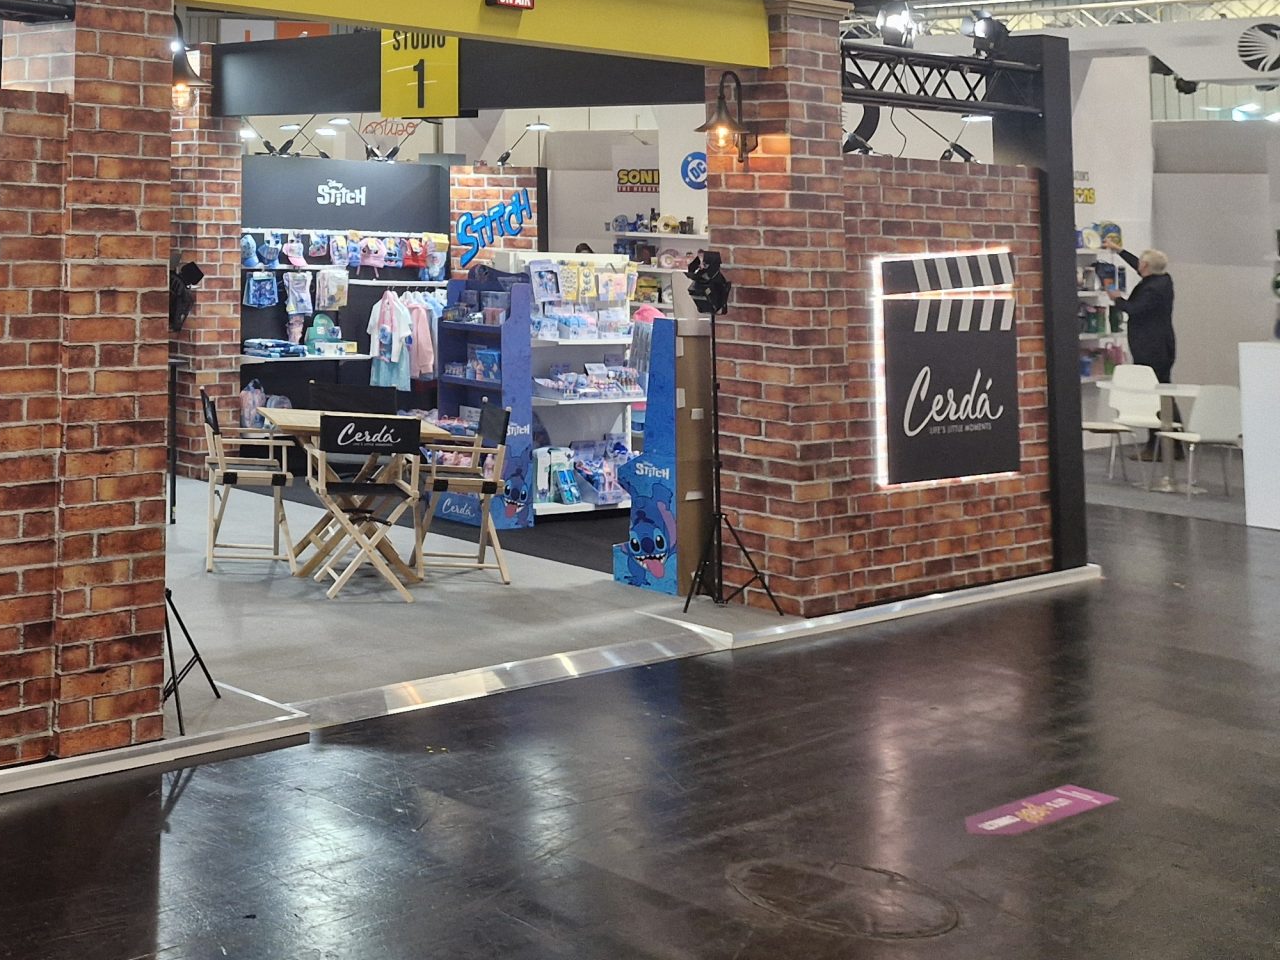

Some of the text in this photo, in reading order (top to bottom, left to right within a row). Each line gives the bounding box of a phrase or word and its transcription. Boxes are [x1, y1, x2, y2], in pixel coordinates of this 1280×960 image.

[392, 30, 446, 51] STUDIO
[413, 58, 425, 109] 1
[689, 161, 707, 180] DC
[456, 187, 533, 268] STITCH
[904, 366, 1003, 437] Cerdá
[337, 422, 401, 445] Cerdá
[442, 498, 476, 517] Cerdá
